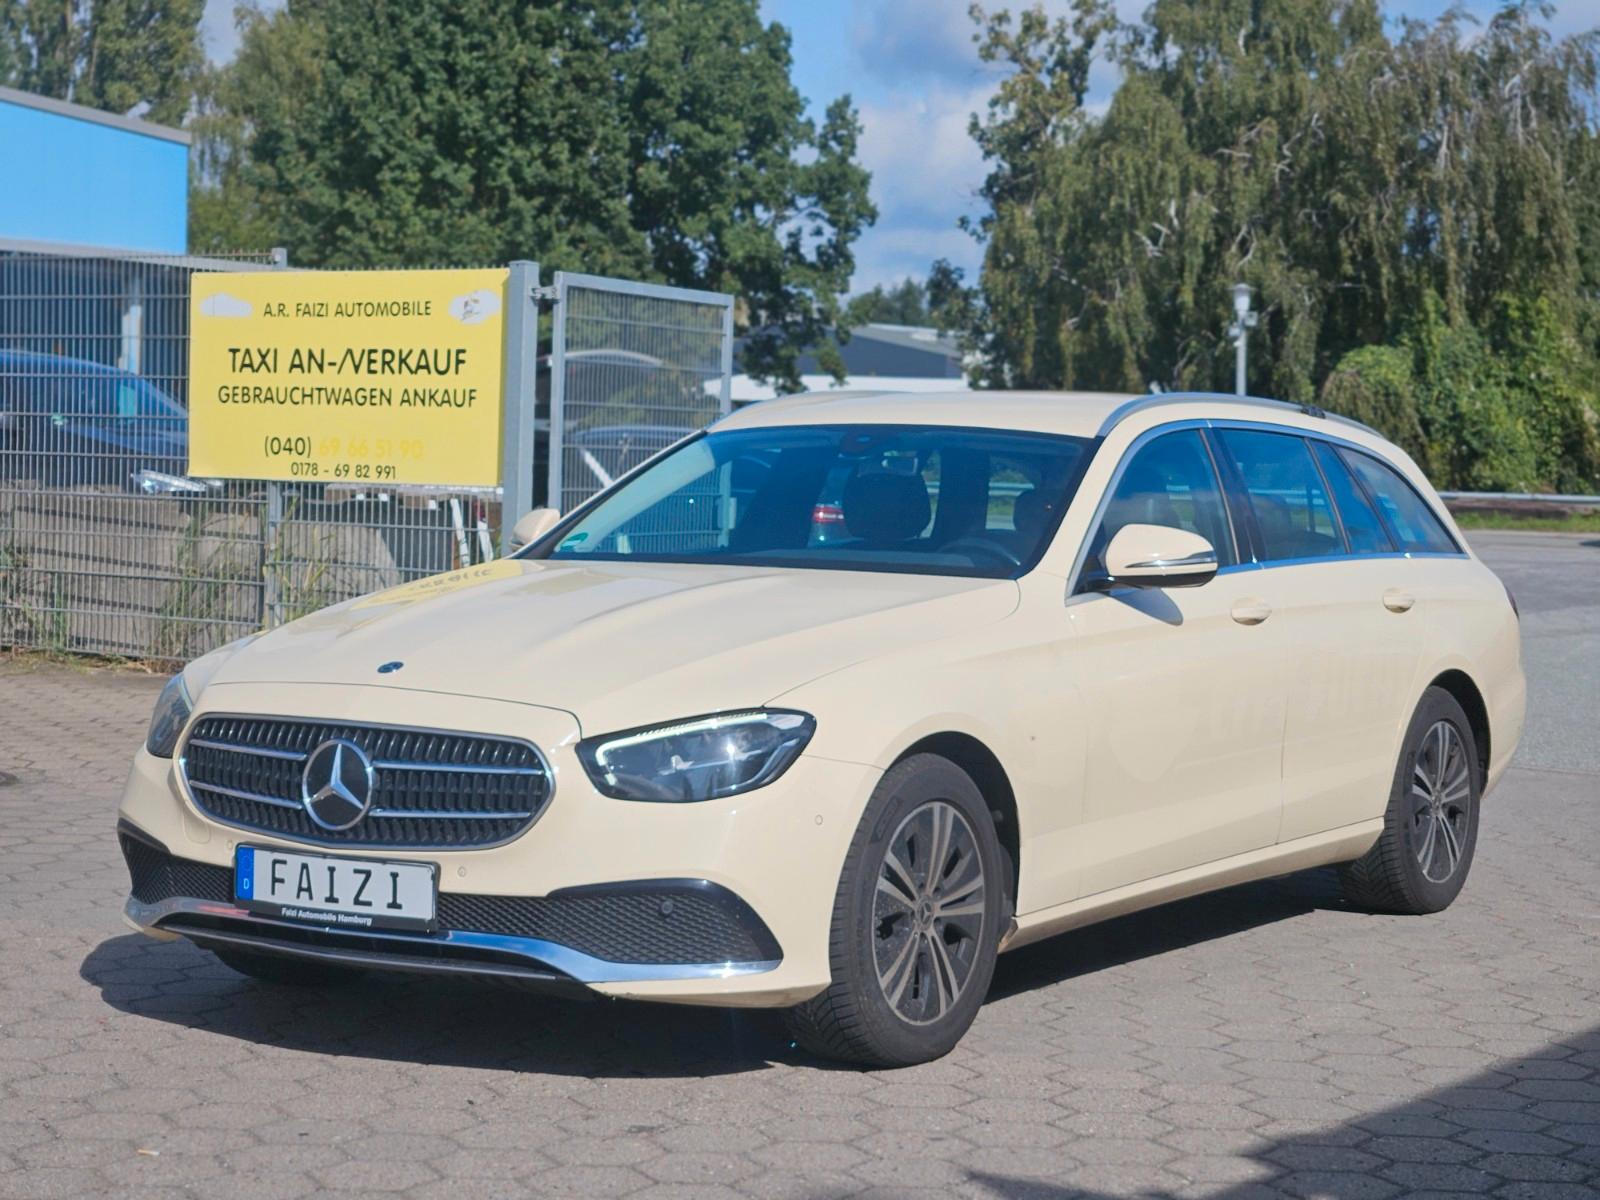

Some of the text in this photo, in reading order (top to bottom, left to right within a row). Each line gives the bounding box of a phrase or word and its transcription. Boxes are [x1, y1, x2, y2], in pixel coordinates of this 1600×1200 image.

[263, 300, 432, 317] A.R. FAIZI AUTOMOBILE
[228, 348, 467, 376] TAXI AN-/VERKAUF
[218, 385, 477, 408] GEBRAUCHTWAGEN ANKAUF
[264, 436, 312, 458] (040)
[291, 462, 319, 477] 0178
[334, 463, 350, 478] 69
[355, 464, 370, 479] 82
[375, 465, 397, 480] 991
[243, 878, 250, 890] D
[270, 858, 403, 910] FAIZI
[338, 913, 373, 927] Hamburg
